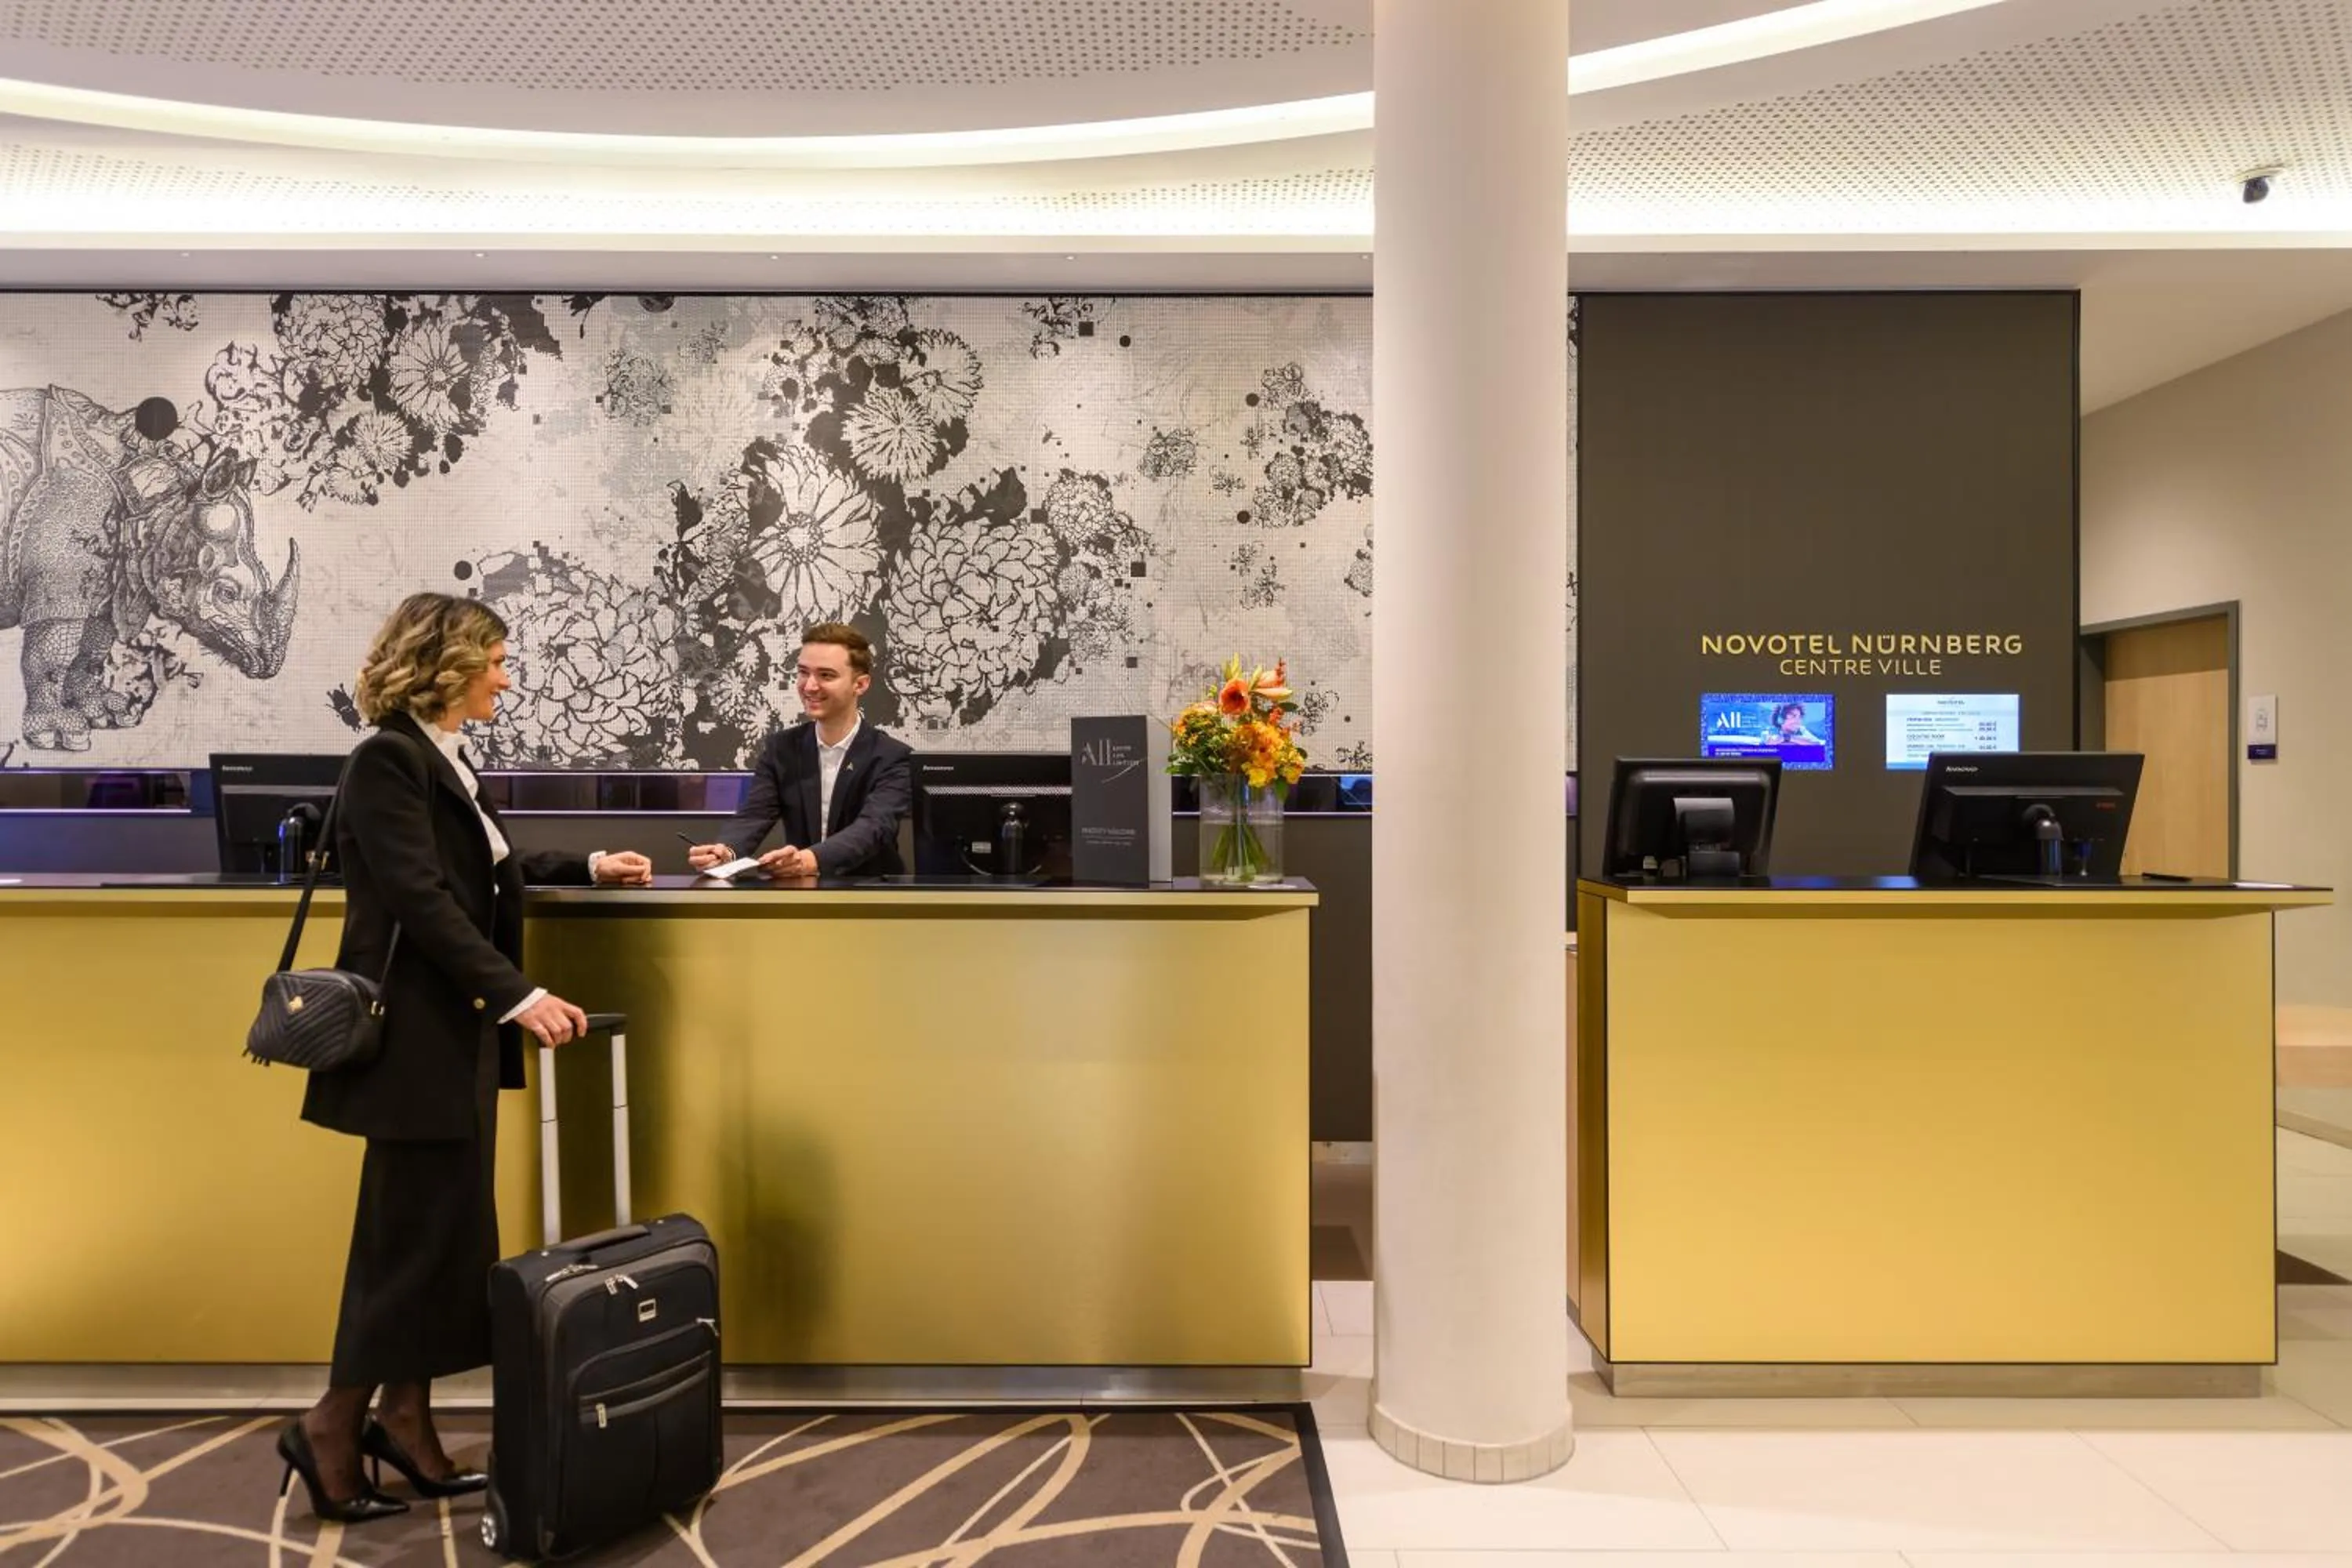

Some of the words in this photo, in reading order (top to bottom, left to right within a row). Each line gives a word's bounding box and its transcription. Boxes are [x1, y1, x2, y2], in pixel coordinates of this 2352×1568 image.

[1701, 635, 1842, 655] NOVOTEL
[1851, 634, 2023, 655] NÜRNBERG
[1779, 659, 1871, 675] CENTRE
[1877, 659, 1942, 675] VILLE
